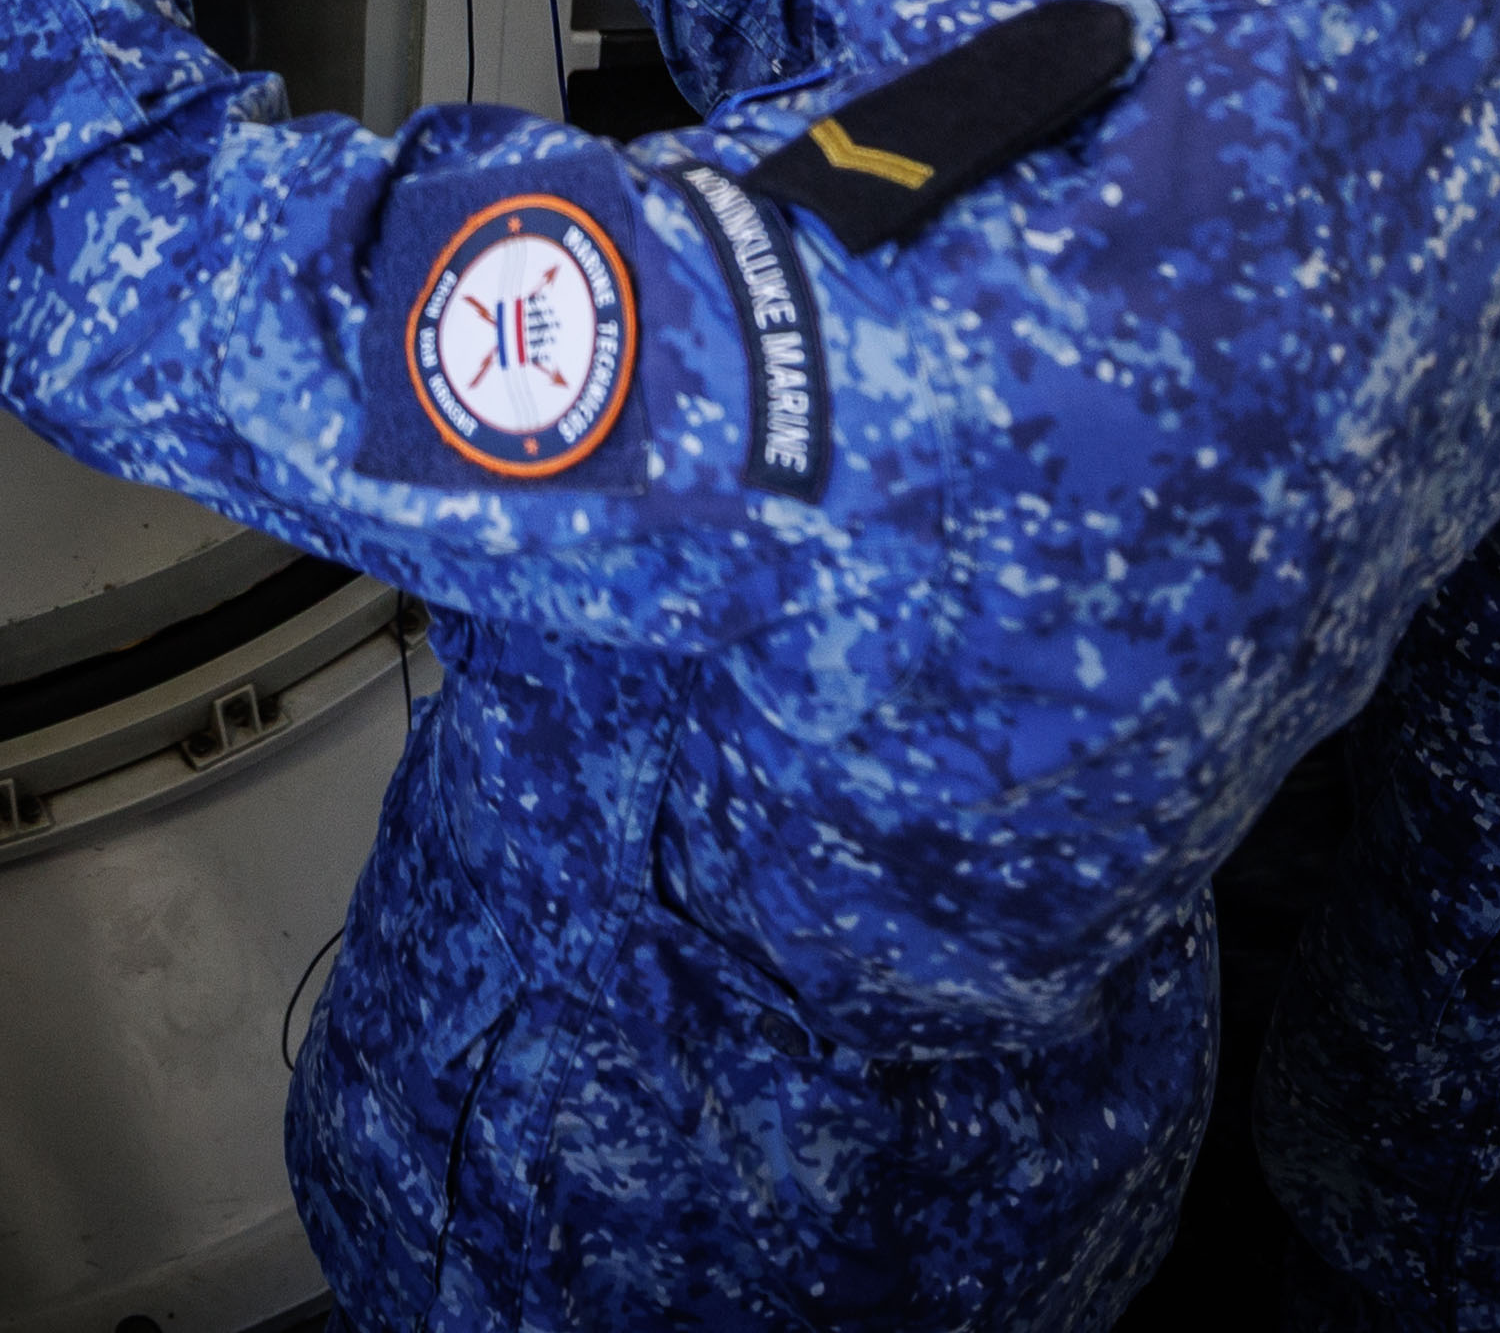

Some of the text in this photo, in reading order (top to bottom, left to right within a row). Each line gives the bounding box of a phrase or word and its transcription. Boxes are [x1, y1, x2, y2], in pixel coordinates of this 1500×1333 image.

[420, 269, 479, 437] BRON VAN KRACHT
[557, 224, 619, 444] MARINE TECHNICUS
[682, 166, 810, 473] KONINKLIJKE MARINE
